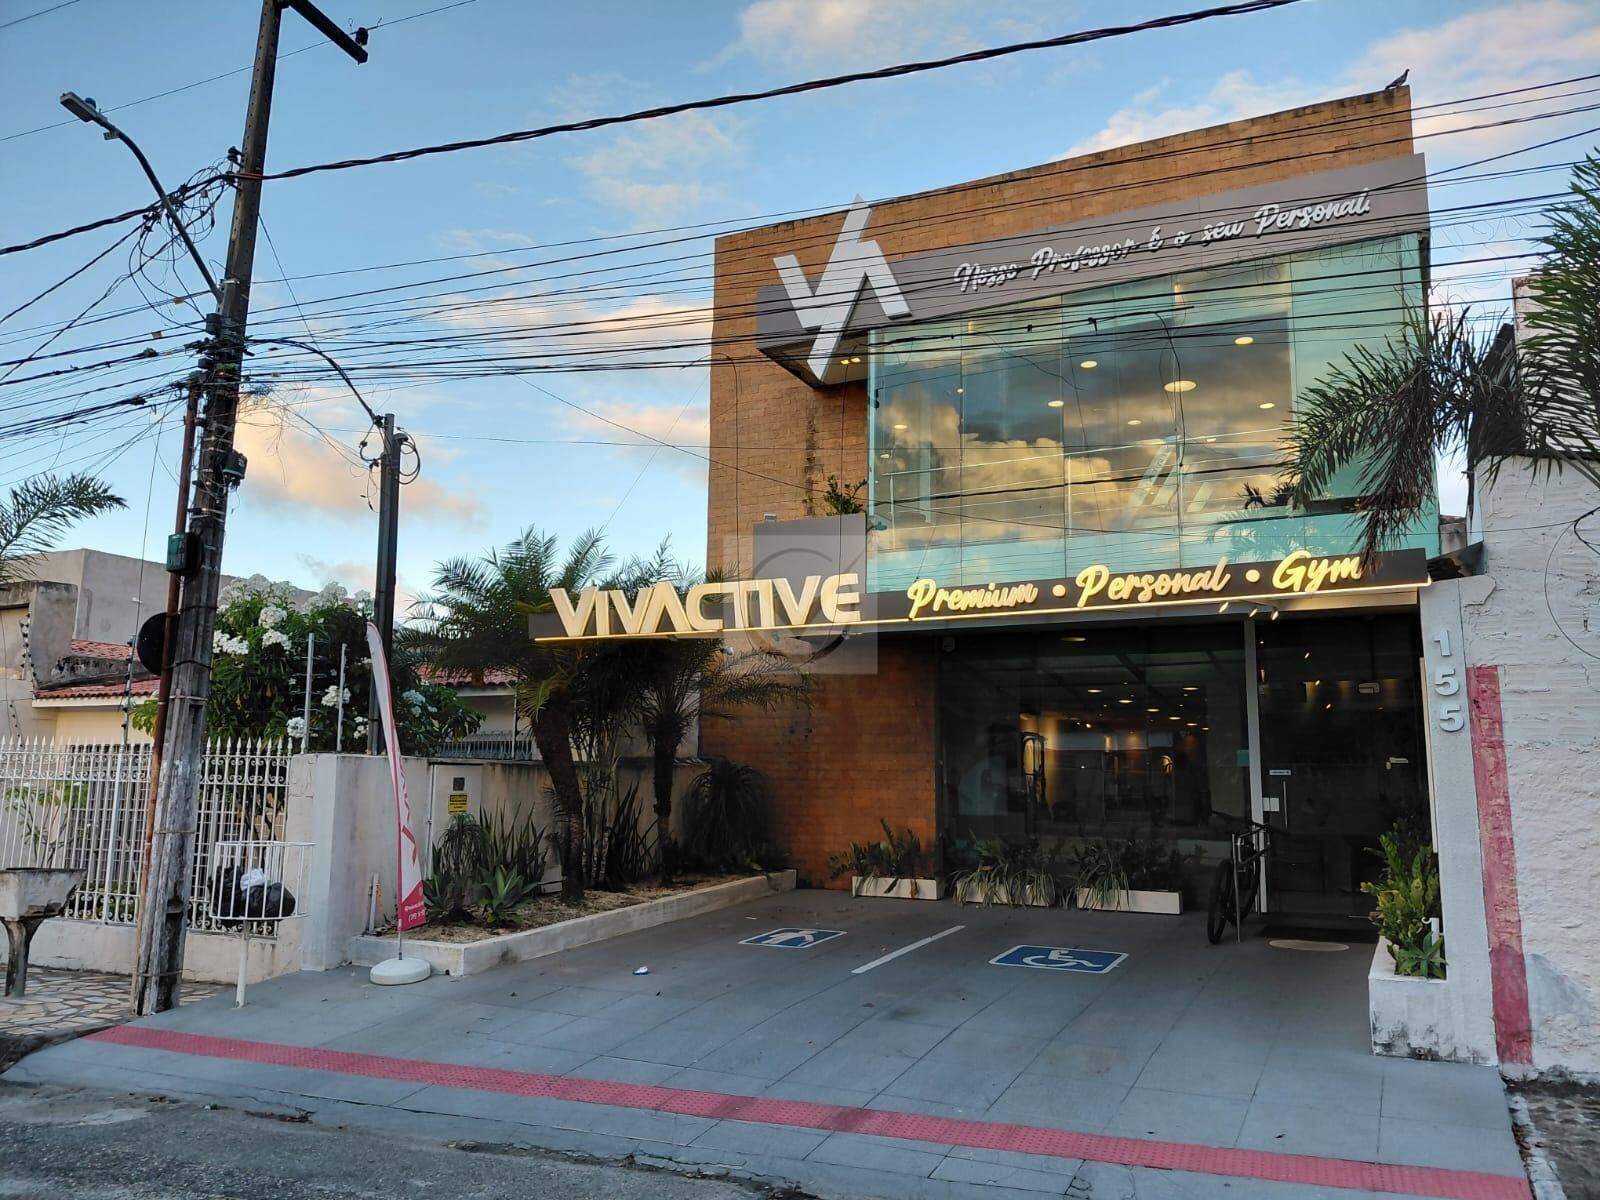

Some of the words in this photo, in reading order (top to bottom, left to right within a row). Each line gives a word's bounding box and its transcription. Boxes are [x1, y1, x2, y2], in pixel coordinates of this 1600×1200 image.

[954, 262, 1020, 292] Nosso
[1031, 247, 1135, 280] Professor
[1201, 220, 1245, 246] seu
[549, 573, 861, 637] VIVACTIVE
[907, 578, 1038, 619] Premium
[1075, 556, 1231, 608] Personal
[1272, 550, 1361, 593] Gym
[1434, 629, 1465, 732] 155
